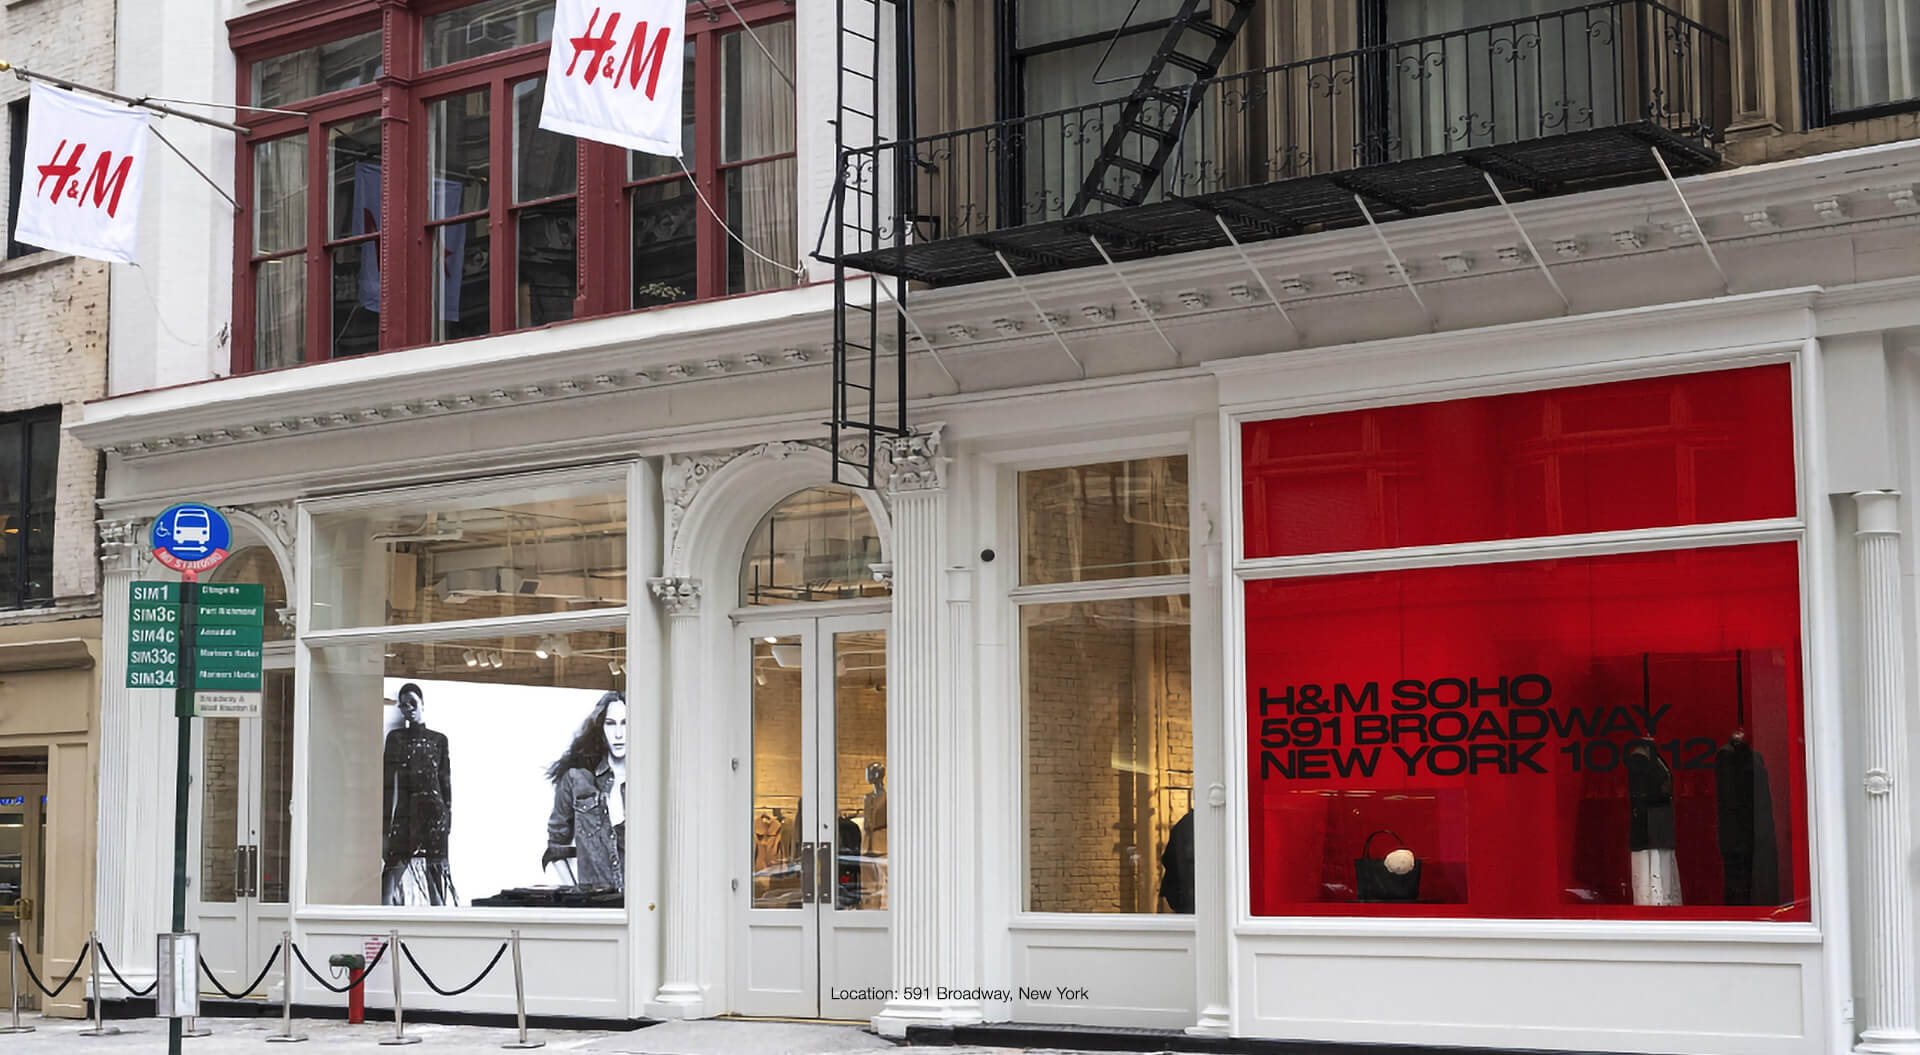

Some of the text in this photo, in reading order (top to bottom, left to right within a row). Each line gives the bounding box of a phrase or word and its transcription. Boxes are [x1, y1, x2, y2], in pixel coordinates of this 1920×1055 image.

[566, 7, 671, 101] H&M
[37, 139, 134, 219] H&M
[134, 584, 169, 601] SIM1
[133, 606, 176, 622] SIM3c
[132, 627, 175, 643] SIM4c
[131, 648, 176, 665] SIM33c
[131, 669, 175, 686] SIM34
[1259, 673, 1552, 716] H&M SOHO
[1260, 703, 1673, 748] 591 BROADWAY
[1261, 747, 1381, 780] NEW
[1392, 742, 1548, 777] YORK
